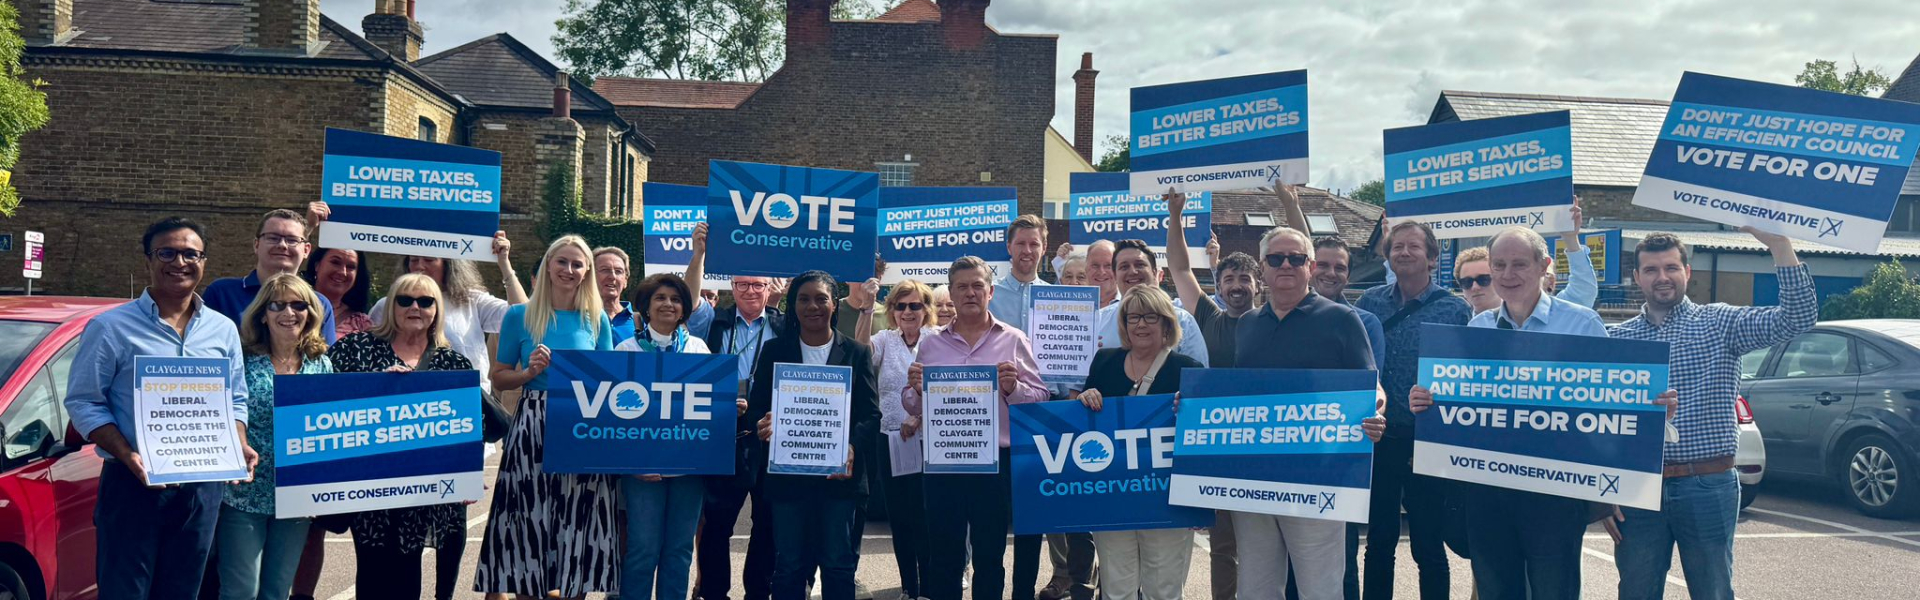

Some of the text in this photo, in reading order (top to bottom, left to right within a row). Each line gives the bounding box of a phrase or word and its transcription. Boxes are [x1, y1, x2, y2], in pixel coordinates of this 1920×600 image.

[1153, 98, 1283, 130] LOWER TAXES,
[1138, 112, 1299, 148] BETTER SERVICES
[1681, 108, 1906, 142] DON'T JUST HOPE FOR
[1671, 124, 1900, 159] AN EFFICIENT COUNCIL
[1408, 141, 1545, 173] LOWER TAXES,
[1677, 146, 1879, 186] VOTE FOR ONE
[349, 166, 478, 188] LOWER TAXES,
[1158, 169, 1264, 184] VOTE CONSERVATIVE
[1394, 155, 1563, 193] BETTER SERVICES
[332, 183, 492, 203] BETTER SERVICES
[1079, 195, 1114, 205] DON'T
[654, 210, 707, 220] DON'T JU
[729, 190, 855, 233] VOTE
[887, 204, 1008, 220] DON'T JUST HOPE FOR
[1076, 201, 1203, 216] AN EFFICIENT COCIL
[1674, 190, 1819, 229] VOTE CONSERVATIVE
[652, 221, 670, 232] AN
[885, 215, 1010, 232] AN EFFICIENT COUNCIL
[1083, 220, 1123, 233] VOTE
[1127, 218, 1158, 230] FOR
[1445, 216, 1526, 229] CONSERVATIVE
[350, 232, 458, 249] VOTE CONSERVATIVE
[660, 238, 694, 251] VOT
[730, 229, 853, 251] Conservative
[892, 230, 1004, 250] VOTE FOR ONE
[145, 366, 221, 374] CLAYGATE NEWS
[783, 371, 820, 379] CLAYGATE
[1433, 364, 1650, 384] DON'T JUST HOPE FOR
[144, 383, 223, 392] STOP PRESS!
[810, 386, 843, 394] PRESS!
[1429, 382, 1652, 404] AN EFFICIENT COUNCIL
[571, 381, 712, 420] VOTE
[151, 410, 219, 418] DEMOCRATS
[305, 401, 456, 431] LOWER TAXES,
[784, 408, 838, 416] DEMOCRATS
[1201, 403, 1345, 424] LOWER TAXES,
[1439, 406, 1637, 435] VOTE FOR ONE
[166, 423, 202, 431] CLOSE
[287, 418, 474, 455] BETTER SERVICES
[572, 422, 710, 440] Conservative
[788, 430, 832, 438] CLAYGATE
[1183, 425, 1363, 445] BETTER SERVICES
[160, 435, 218, 443] CLAYGATE
[781, 441, 837, 449] COMMUNITY
[156, 446, 227, 456] COMMUNITY
[1032, 427, 1176, 474] VOTE
[1450, 456, 1596, 486] VOTE CONSERVATIVE
[312, 483, 437, 503] VOTE CONSERVATIVE
[1039, 473, 1169, 496] Conservativ
[1199, 486, 1316, 504] VOTE CONSERVATIVE
